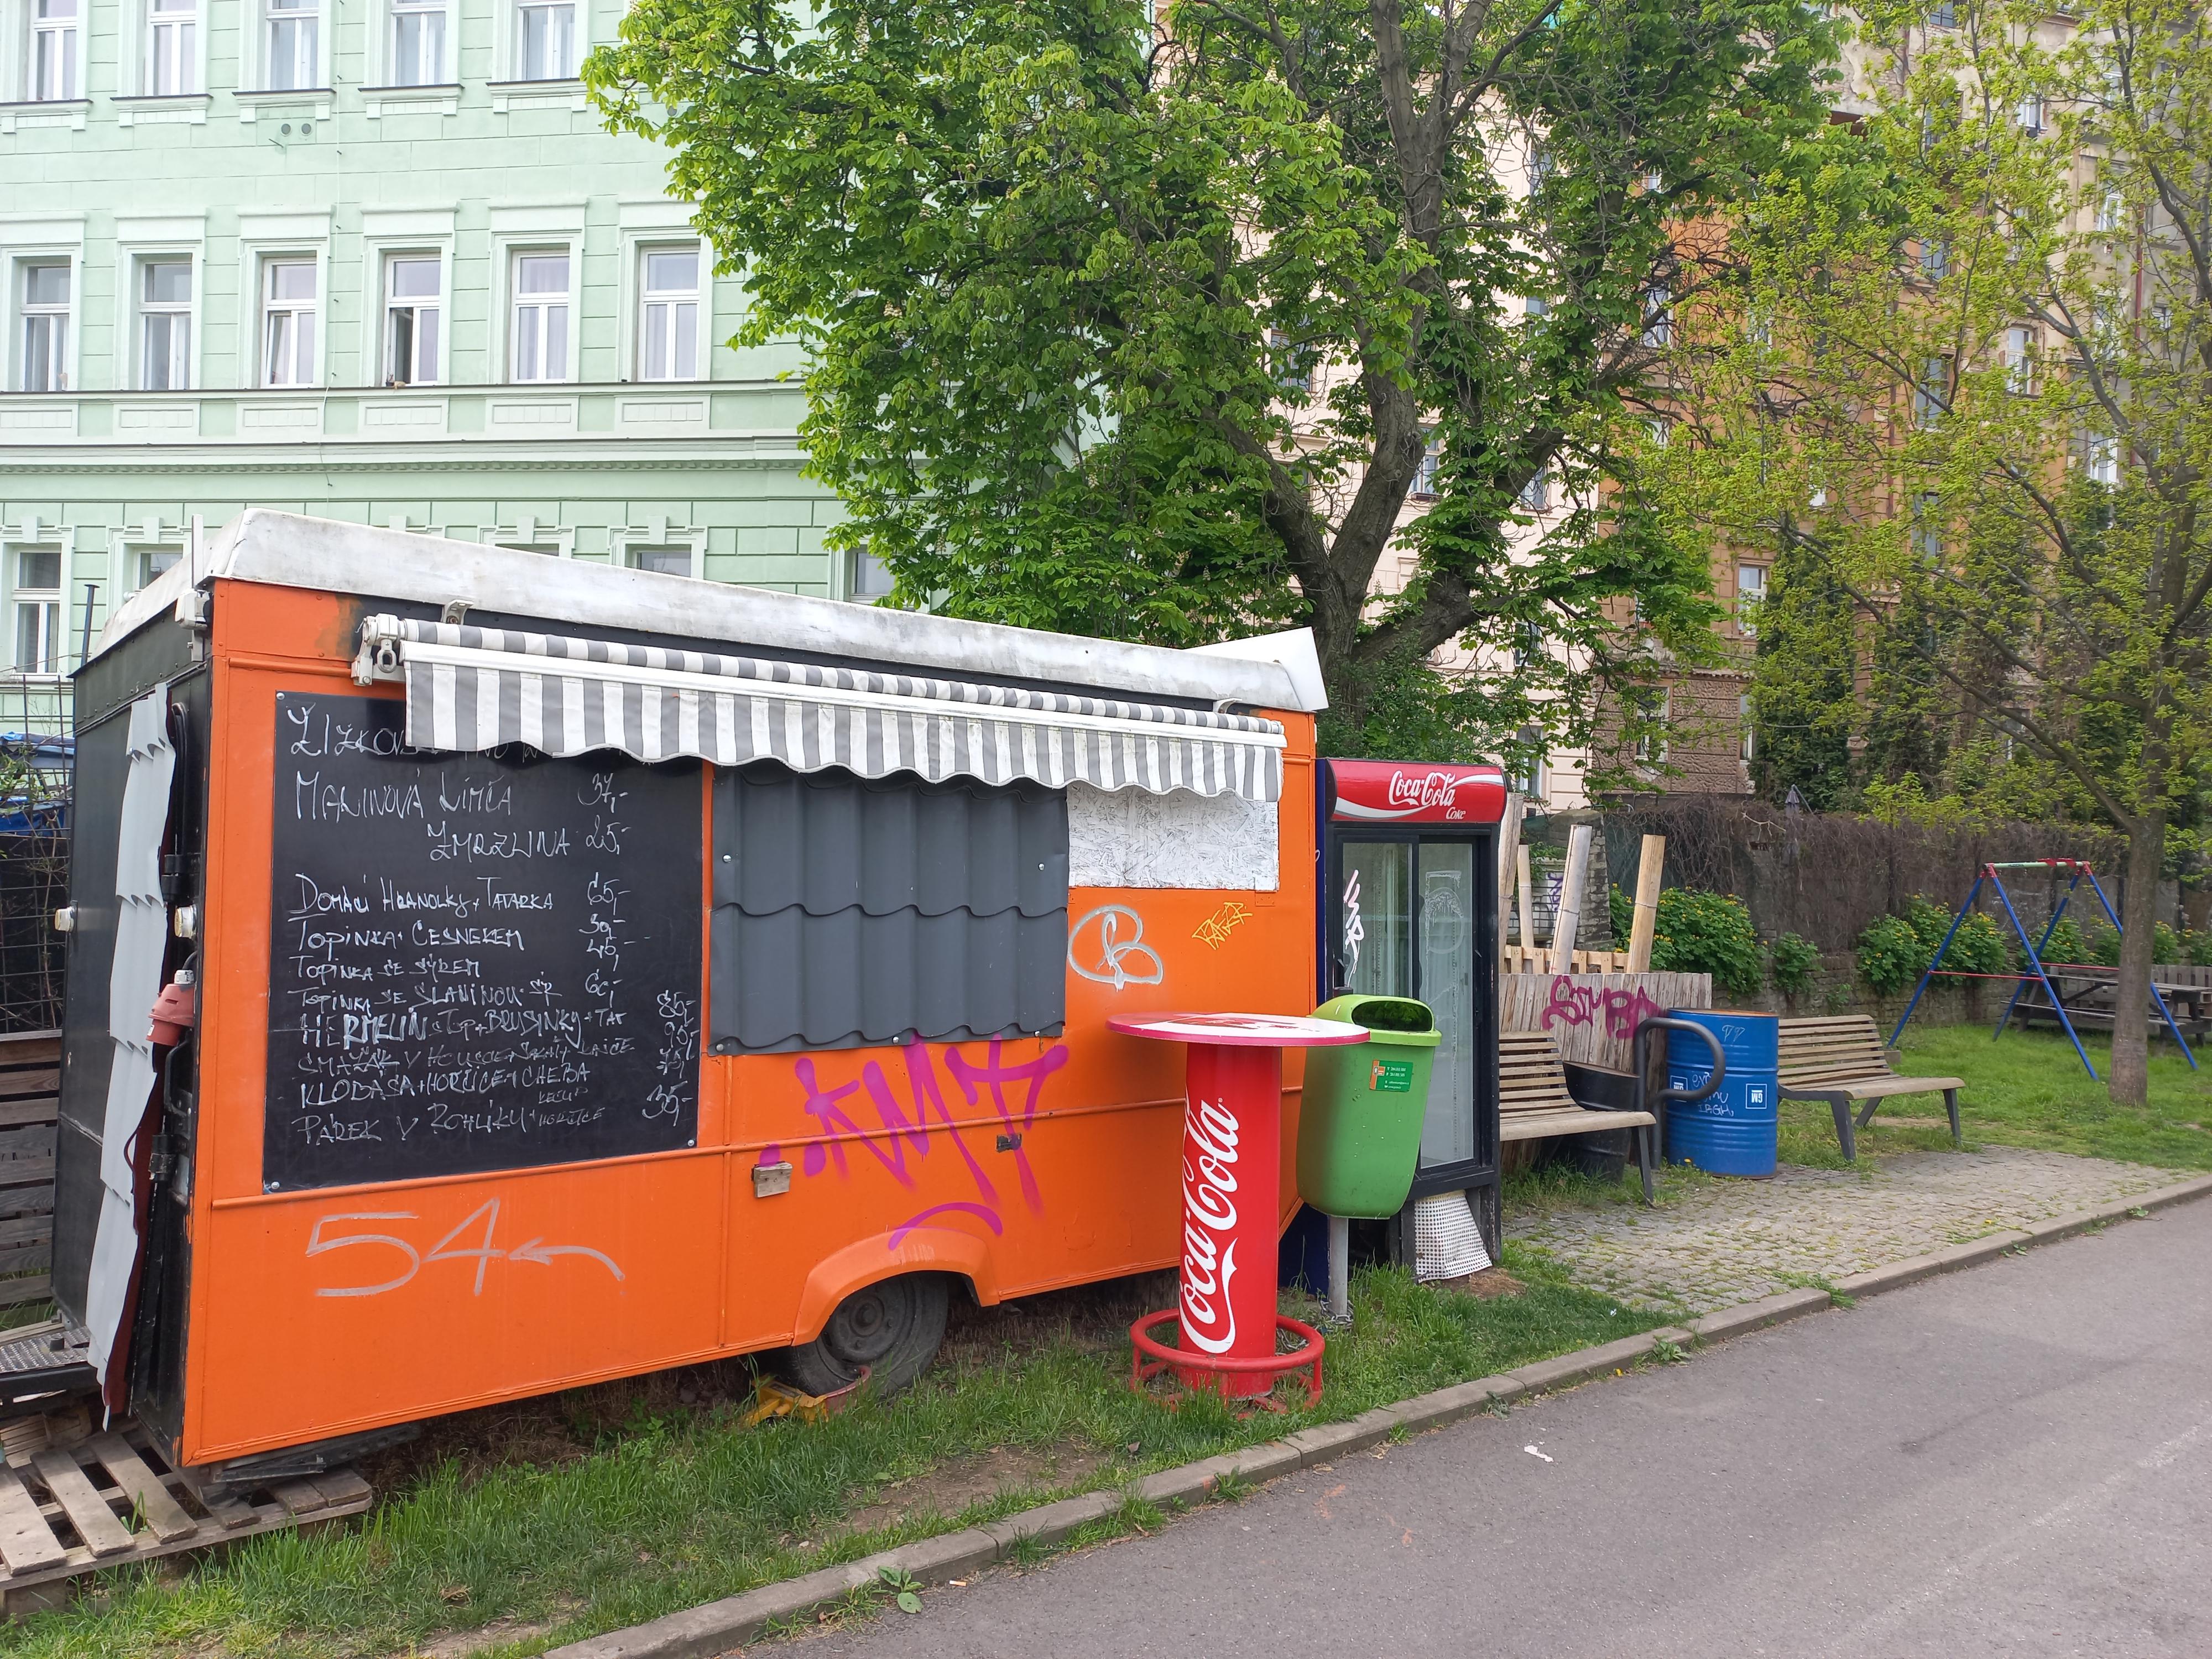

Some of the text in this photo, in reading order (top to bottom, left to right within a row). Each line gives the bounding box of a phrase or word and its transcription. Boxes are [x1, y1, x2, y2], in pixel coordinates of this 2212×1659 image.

[1388, 770, 1456, 806] Coca-Cola
[1446, 806, 1466, 820] Coke
[1178, 1084, 1239, 1354] Coca-Cola
